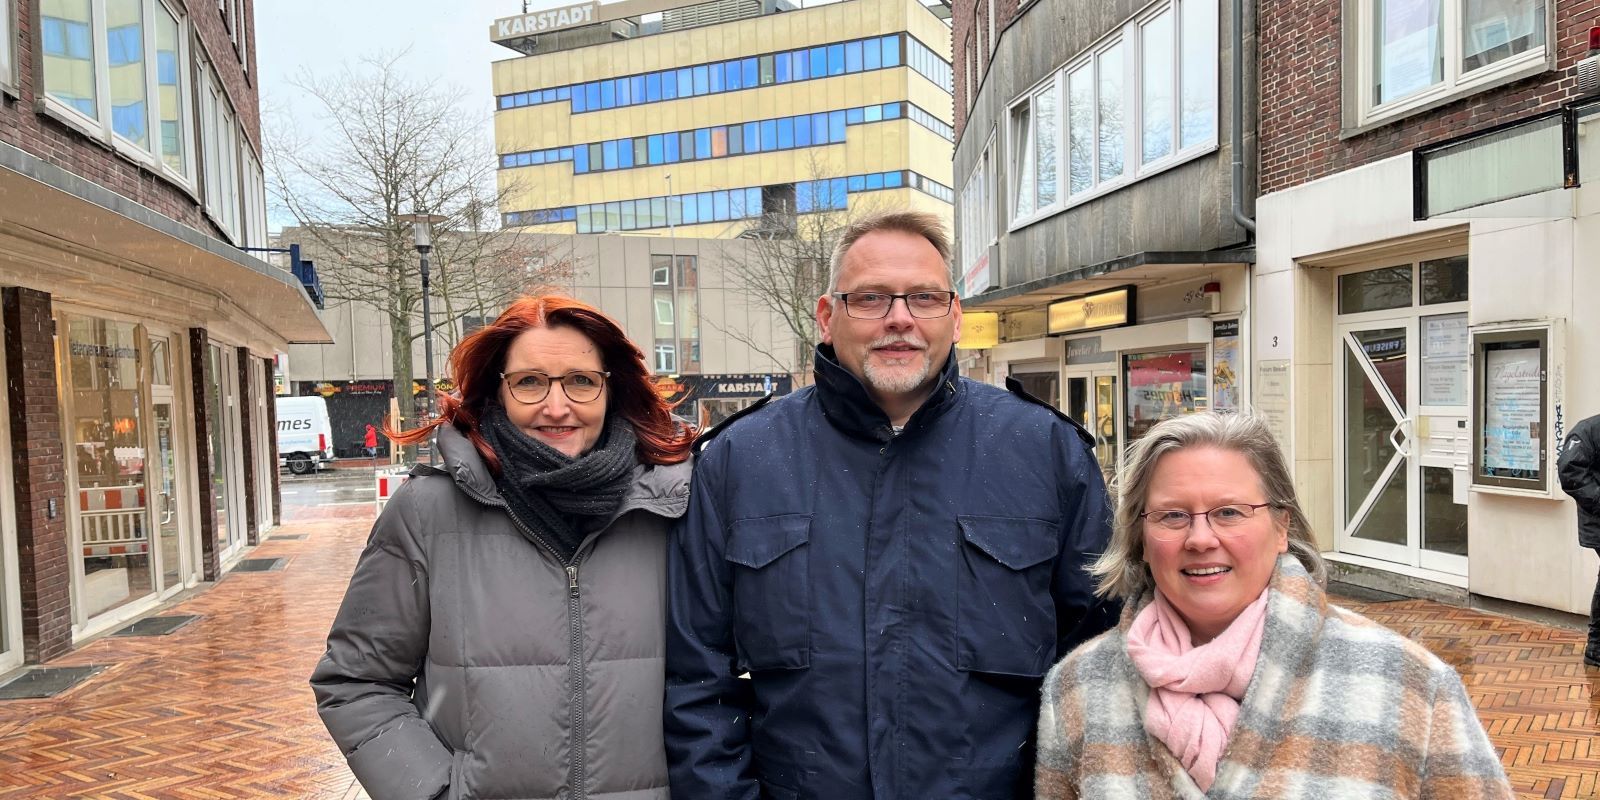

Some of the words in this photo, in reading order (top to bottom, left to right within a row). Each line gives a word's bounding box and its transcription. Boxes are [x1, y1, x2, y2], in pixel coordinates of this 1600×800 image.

[498, 5, 593, 37] KARSTADT
[1272, 336, 1279, 348] 3
[718, 382, 779, 393] KARSTAT
[277, 418, 312, 431] mes
